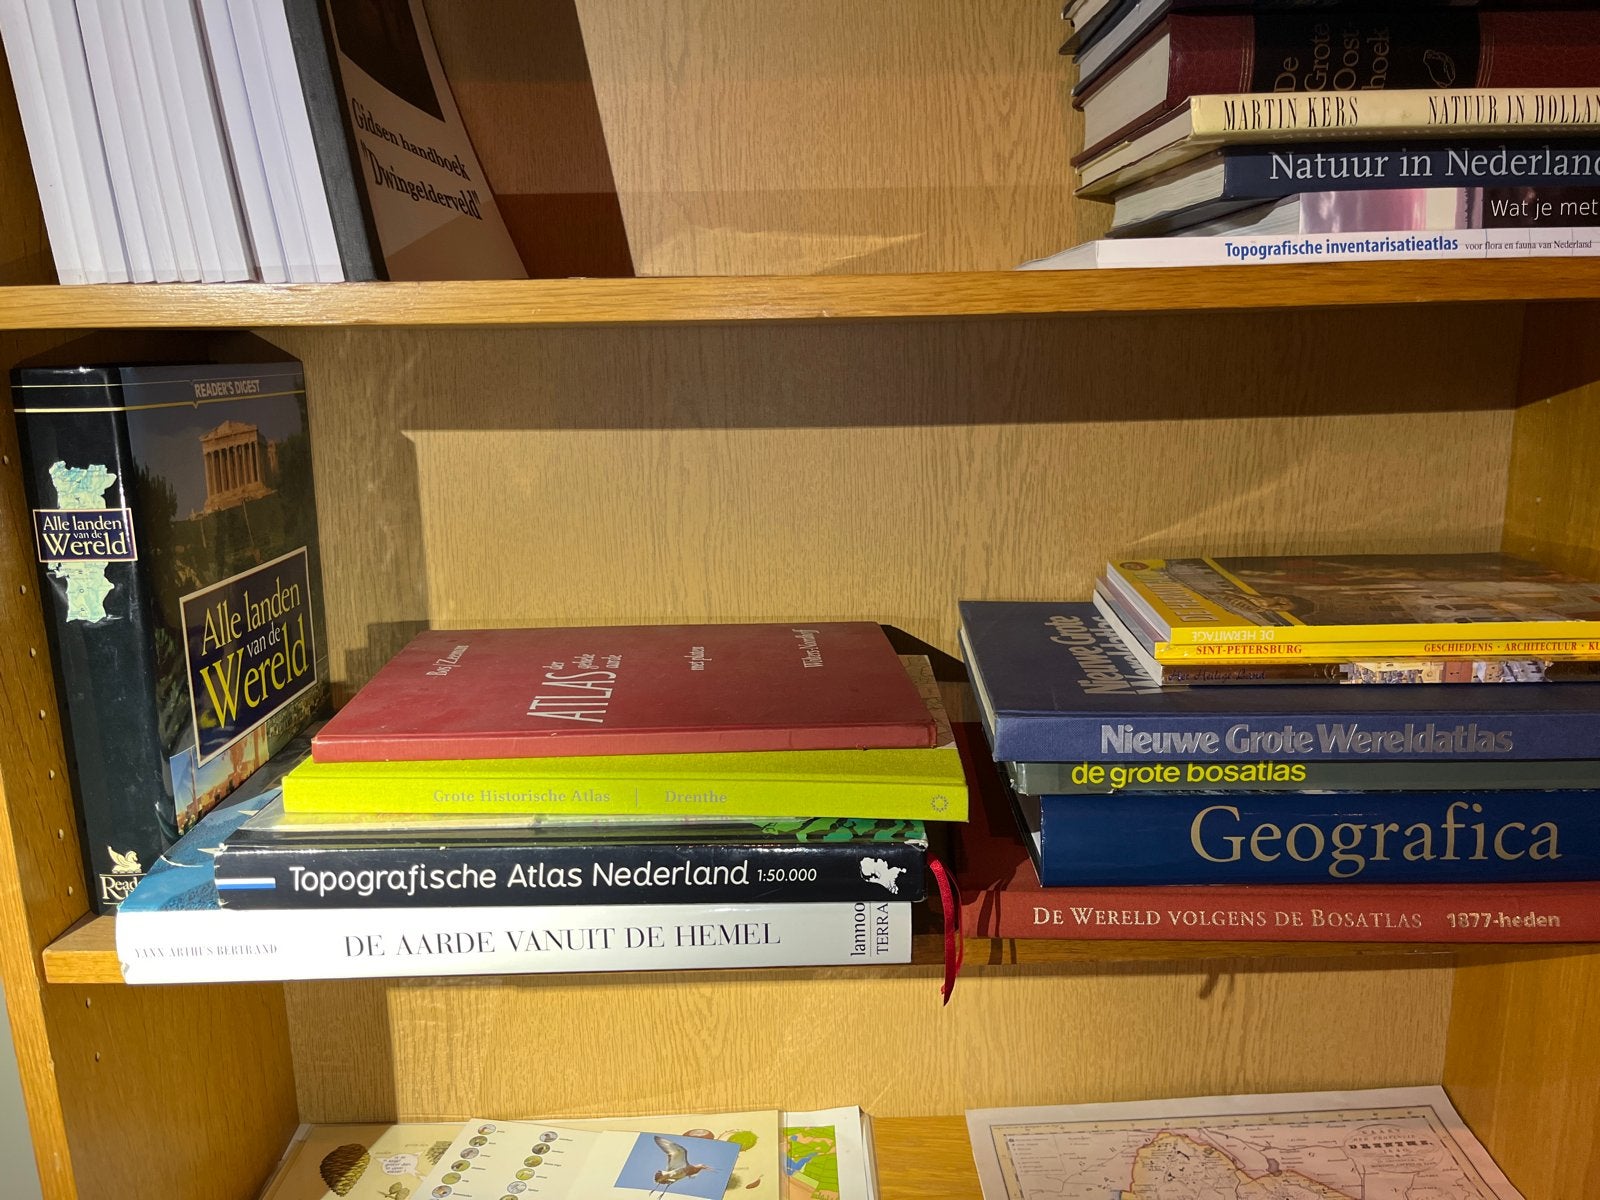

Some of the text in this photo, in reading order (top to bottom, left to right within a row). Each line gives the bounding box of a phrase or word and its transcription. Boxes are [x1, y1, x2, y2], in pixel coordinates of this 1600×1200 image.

[1273, 56, 1299, 93] De
[1304, 23, 1331, 92] Grote
[1361, 26, 1390, 90] hoek
[1223, 96, 1358, 131] MARTIN KERS
[1428, 95, 1498, 125] NATUUR
[1507, 95, 1525, 123] IN
[352, 97, 471, 181] Gidsen handboek
[360, 139, 483, 220] "Dwingelderveld"
[1269, 145, 1600, 180] Natuur in Nederlan
[1491, 198, 1599, 220] Wat je met
[1225, 234, 1458, 260] Topografische inventarisatieatlas
[1484, 241, 1502, 250] flora
[1515, 241, 1536, 249] fauna
[1553, 240, 1592, 249] Nederland
[195, 379, 260, 399] READER'S DIGEST
[43, 516, 122, 531] Alle landen
[91, 530, 102, 539] de
[43, 532, 128, 556] Wereld
[201, 578, 301, 656] Alle landen
[247, 622, 281, 658] van de
[1192, 629, 1274, 642] DE HERMITAGE
[1196, 644, 1302, 655] SINT-PETERSBURG
[1424, 643, 1493, 652] GESCHIEDENIS
[1505, 642, 1577, 651] ARCHITECTUUR
[200, 613, 309, 729] Wereld
[1045, 616, 1136, 695] Nieuwe Grote
[526, 671, 616, 723] ATLAS
[1101, 722, 1514, 755] Nieuwe Grote Wereldatlas
[1071, 761, 1306, 789] de grote bosatlas
[433, 790, 728, 803] Grote Historische Atlas Drenthe
[1190, 802, 1562, 879] Geografica
[289, 860, 817, 896] Topografische Atlas Nederland 1:50.000
[851, 902, 866, 956] lannoo
[877, 902, 889, 955] TERRA
[1446, 911, 1561, 928] 1877-heden
[345, 922, 781, 958] DE AARDE VANUIT DE HEMEL
